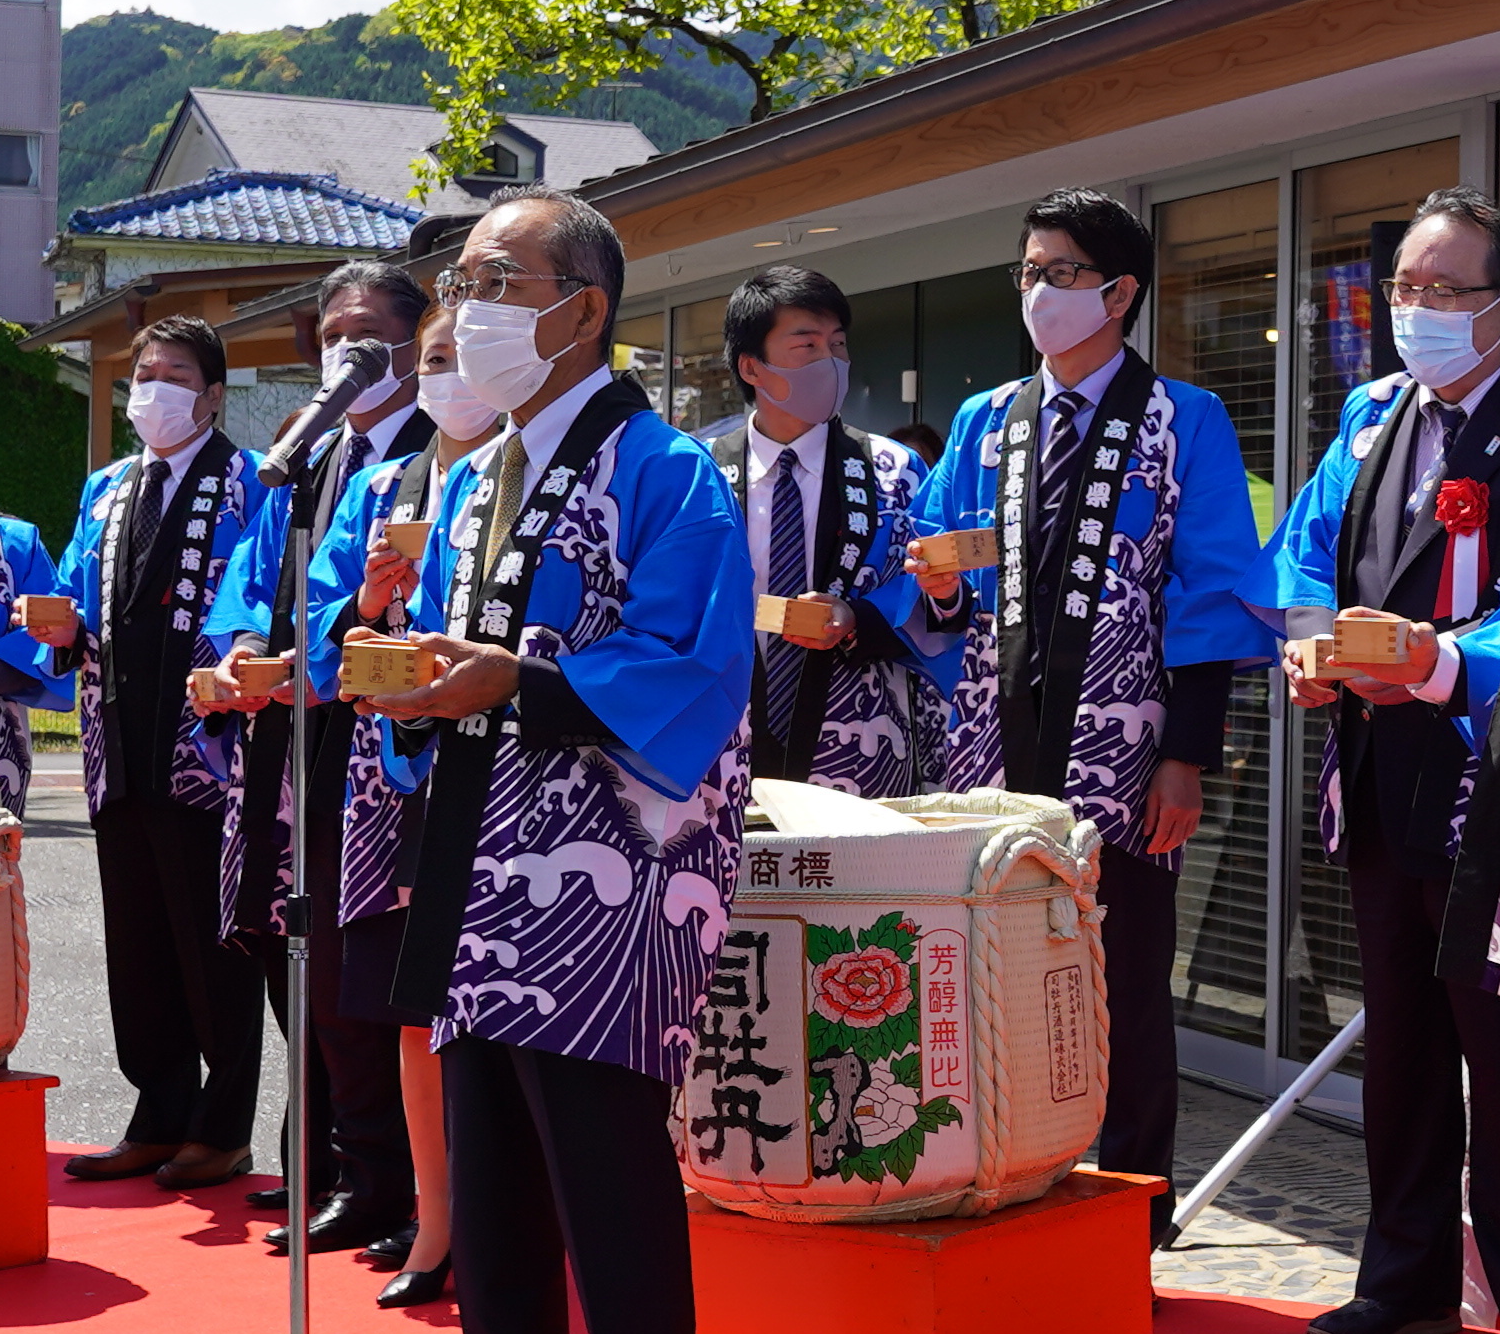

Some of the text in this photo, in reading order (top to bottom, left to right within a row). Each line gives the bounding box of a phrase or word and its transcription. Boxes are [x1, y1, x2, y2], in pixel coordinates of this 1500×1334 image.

[172, 475, 220, 633] 高知県宿毛市
[1064, 418, 1132, 620] 高知県宿毛市
[748, 848, 835, 890] 商標
[927, 943, 962, 1089] 芳醇無比
